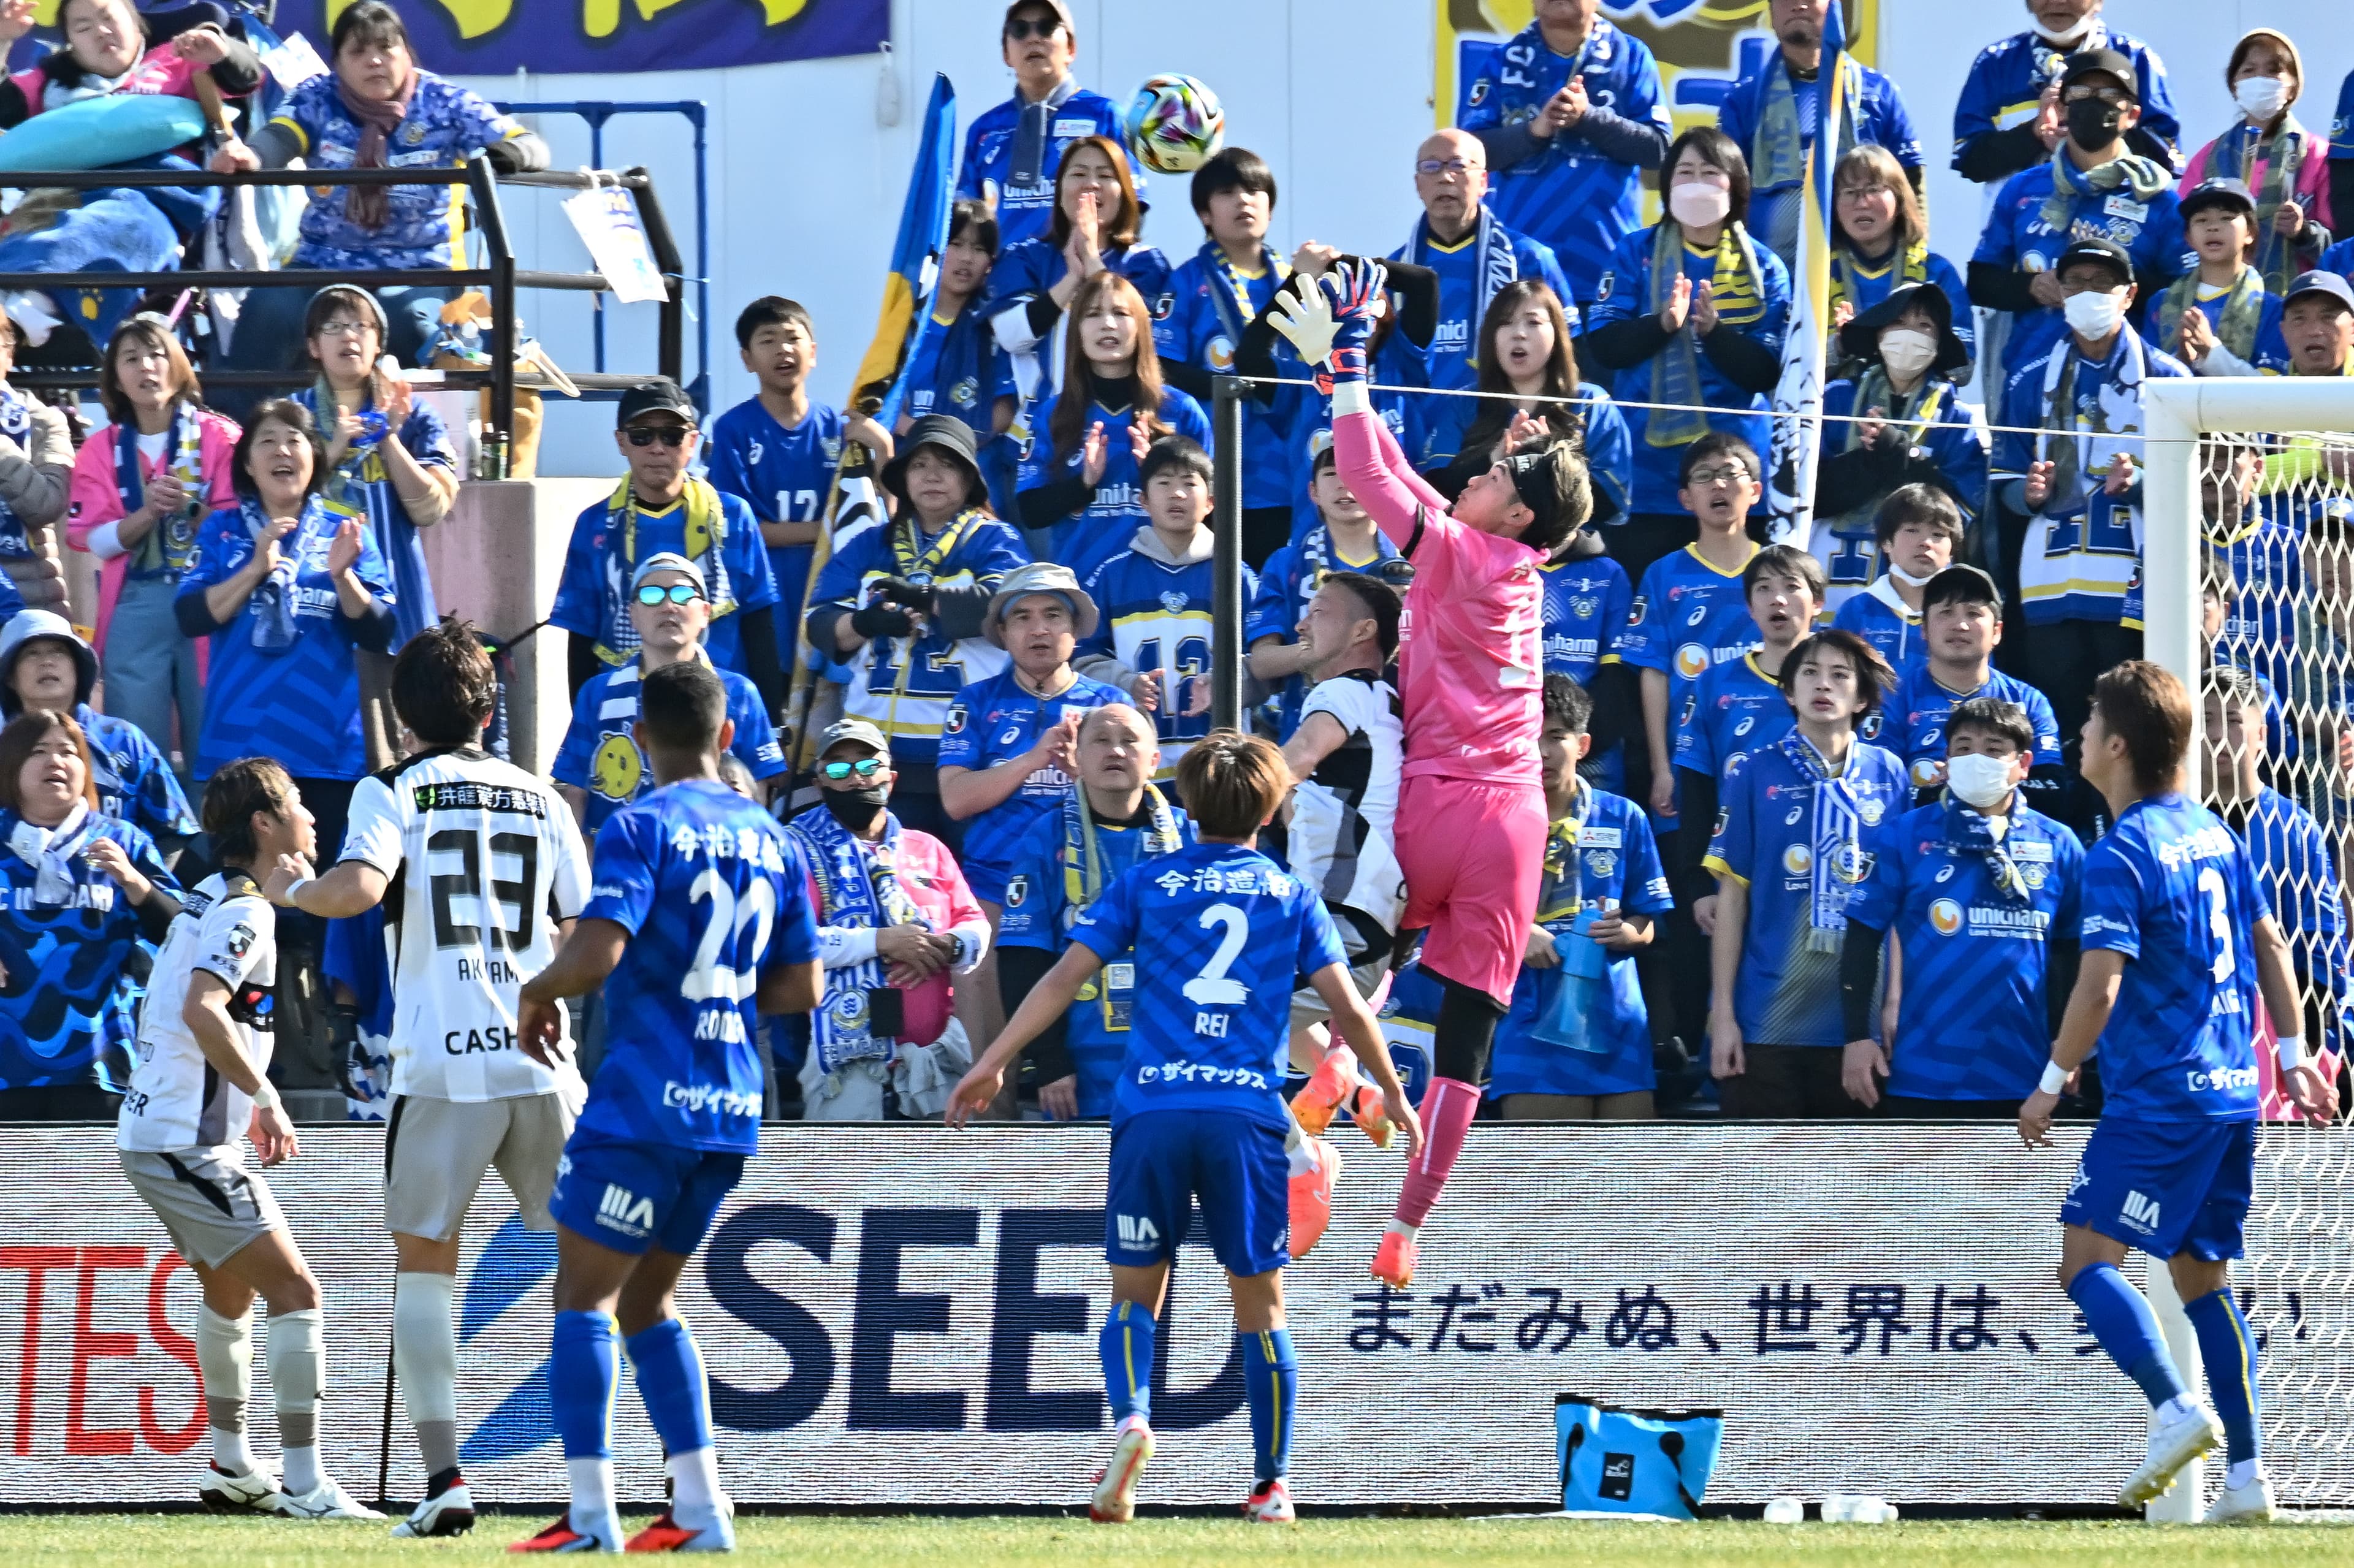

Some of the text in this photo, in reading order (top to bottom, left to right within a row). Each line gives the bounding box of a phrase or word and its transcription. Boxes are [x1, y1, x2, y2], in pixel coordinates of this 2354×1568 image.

[427, 829, 539, 954] 23
[680, 869, 776, 1005] 20
[2198, 867, 2236, 984] 3
[1181, 903, 1252, 1006] 2
[1162, 1059, 1268, 1090] ザイマックス
[1195, 1012, 1230, 1038] REI
